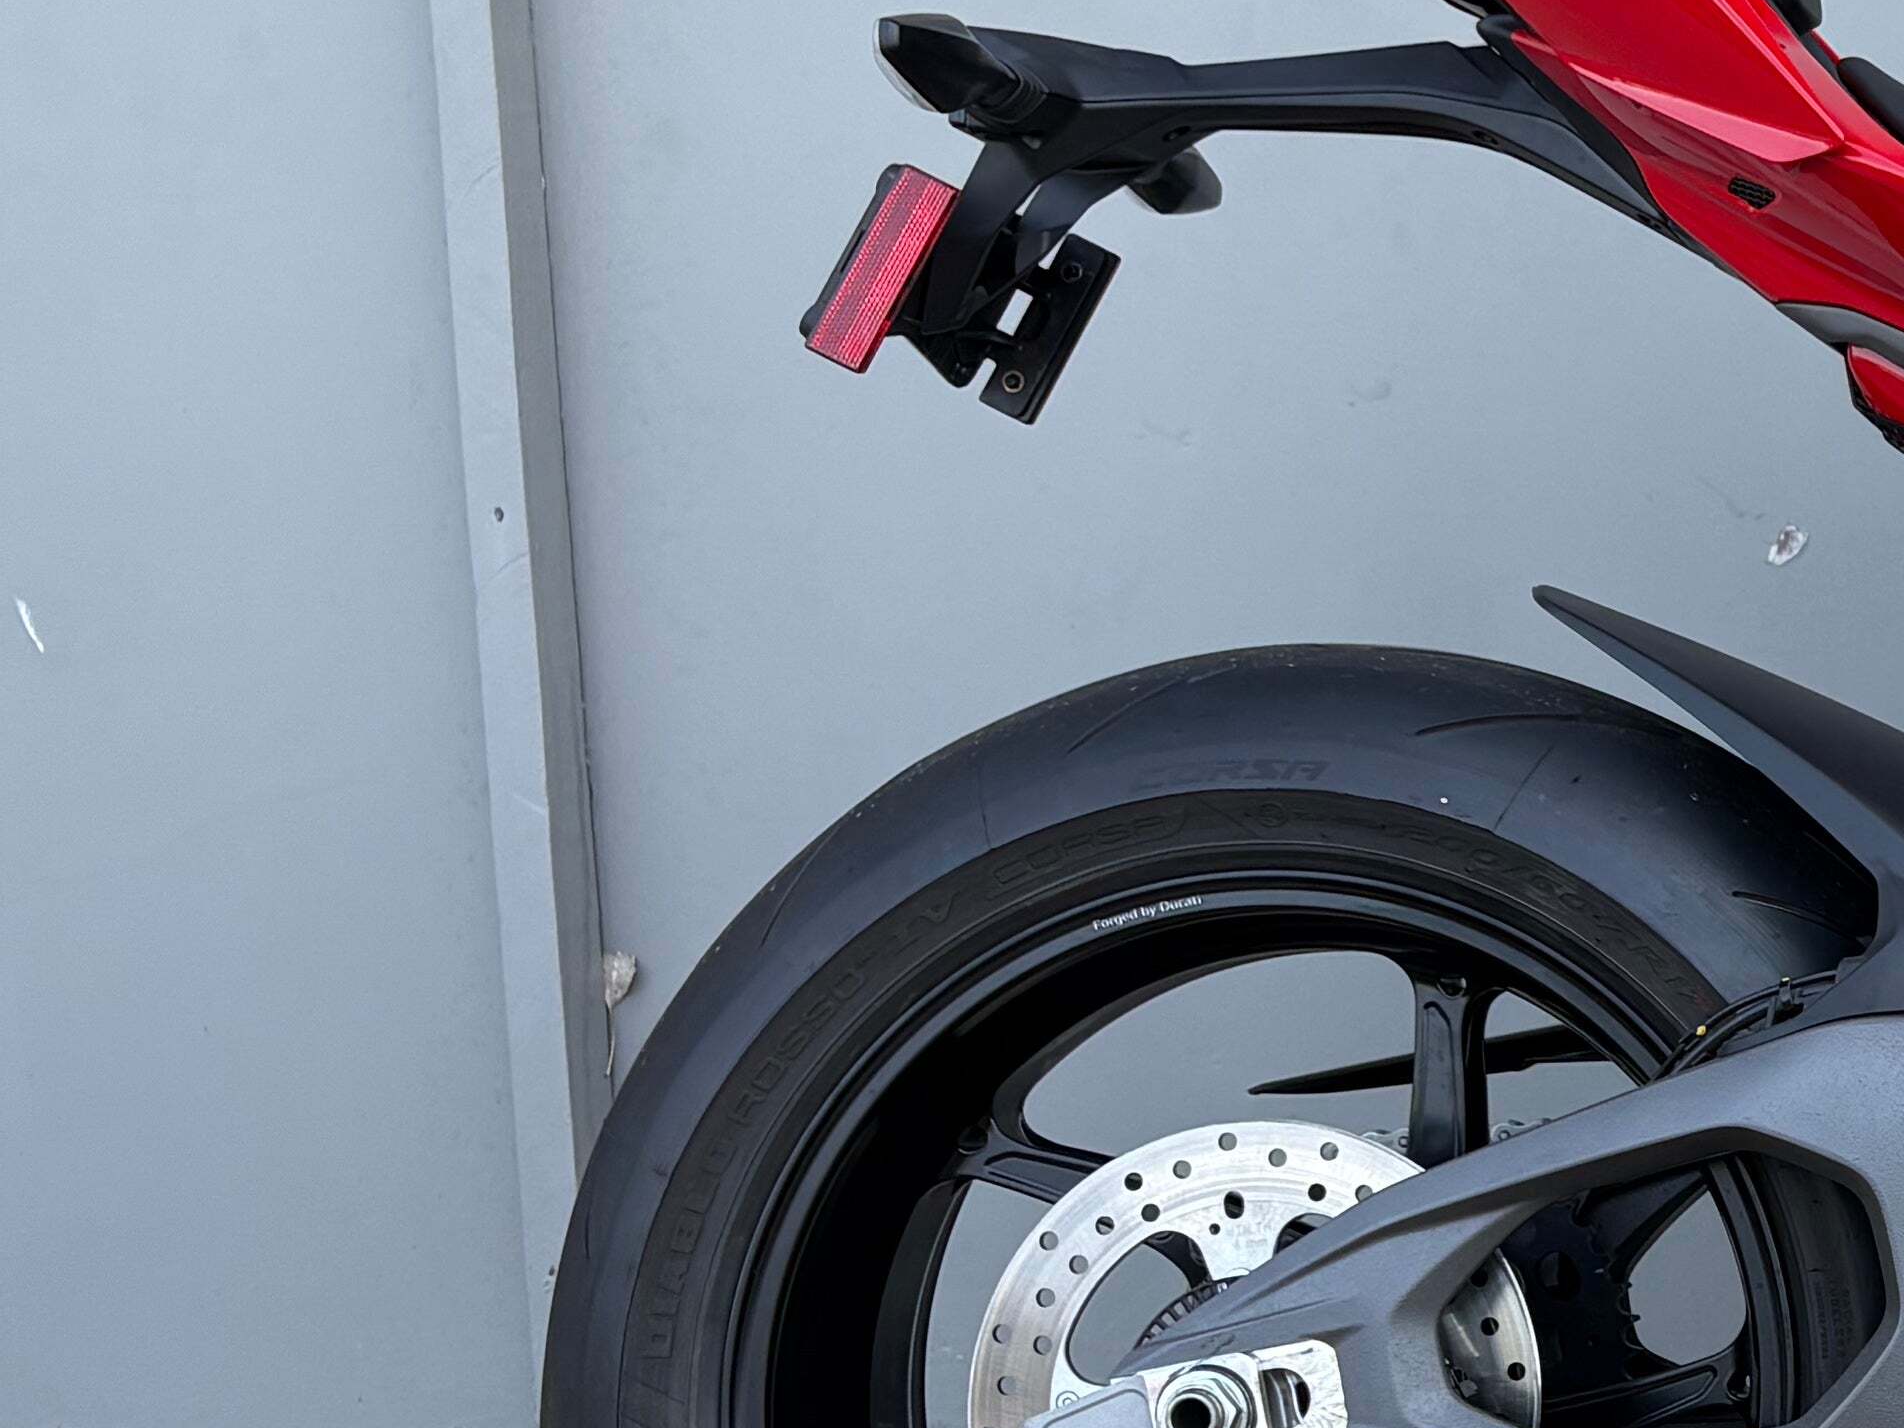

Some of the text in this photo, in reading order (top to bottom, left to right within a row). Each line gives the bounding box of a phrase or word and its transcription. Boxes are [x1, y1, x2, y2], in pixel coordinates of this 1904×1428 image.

[1092, 894, 1203, 930] Forged by Ducati
